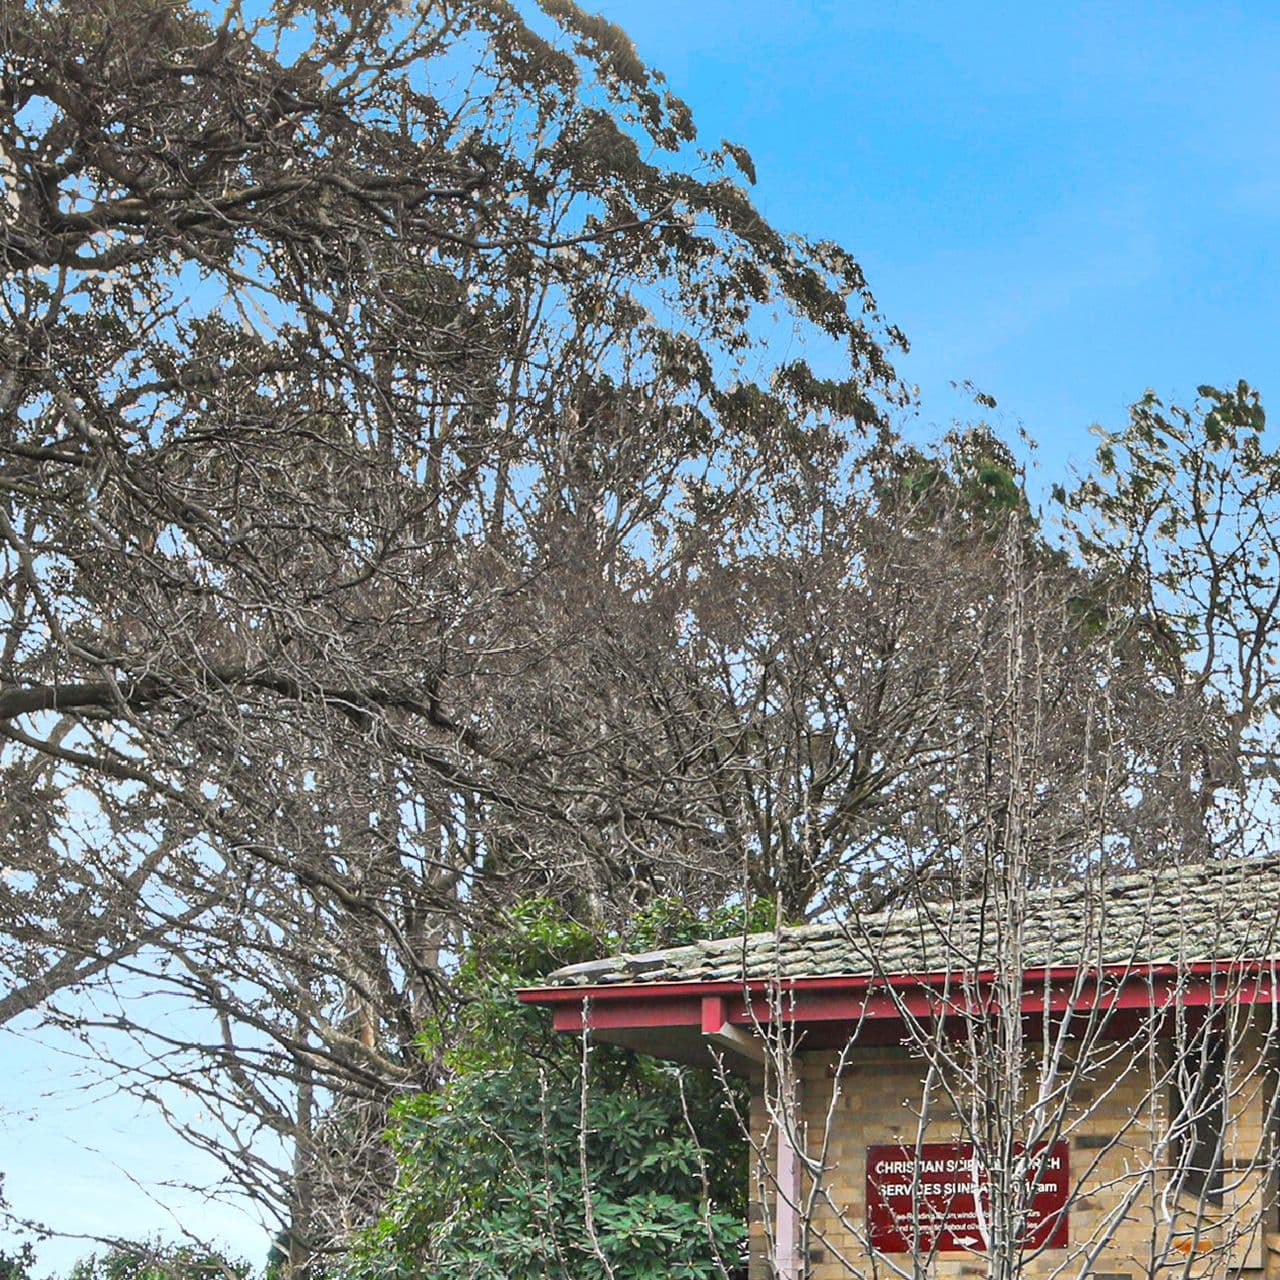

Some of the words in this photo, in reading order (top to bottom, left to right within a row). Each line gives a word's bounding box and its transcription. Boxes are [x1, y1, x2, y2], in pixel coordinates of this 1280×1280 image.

[875, 1160, 944, 1174] CHRISIAN
[946, 1157, 1001, 1172] SCIEN
[880, 1183, 942, 1196] SERVCES
